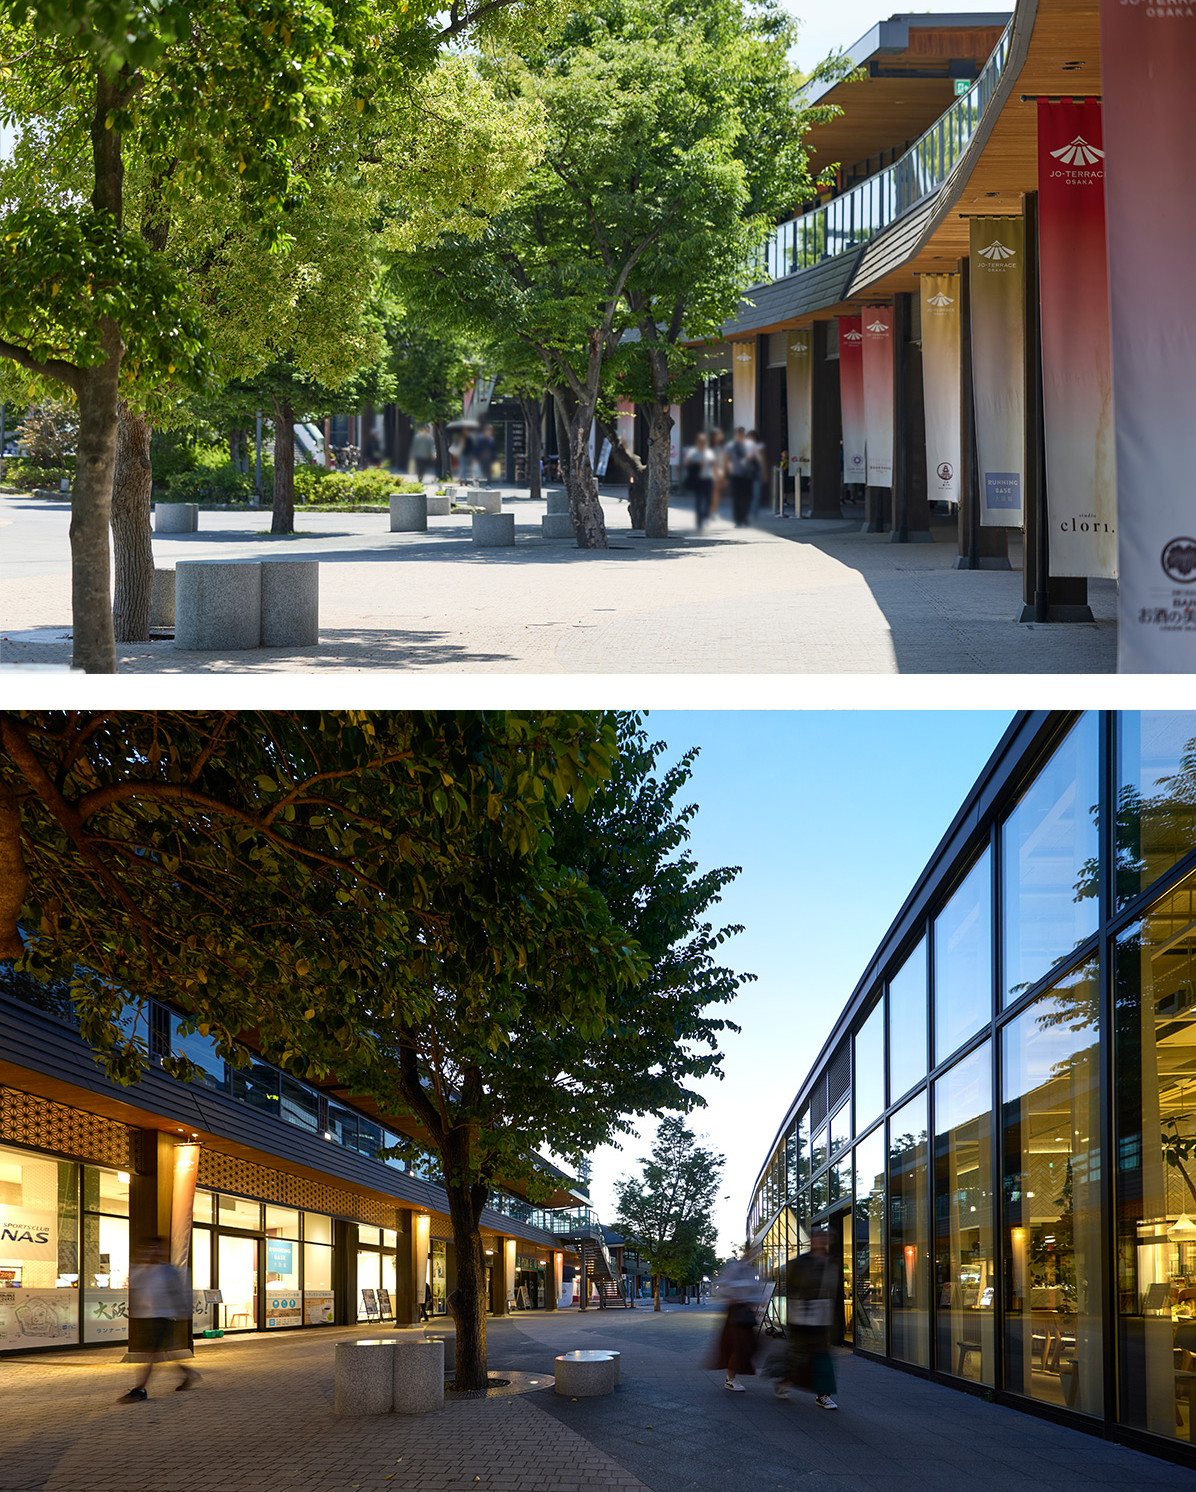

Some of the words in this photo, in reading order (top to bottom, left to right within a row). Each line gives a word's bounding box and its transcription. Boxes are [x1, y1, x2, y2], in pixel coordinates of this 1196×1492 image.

[1146, 7, 1194, 18] OSAKA
[1050, 170, 1106, 179] JO-TERRAC
[1, 1228, 49, 1244] NAS
